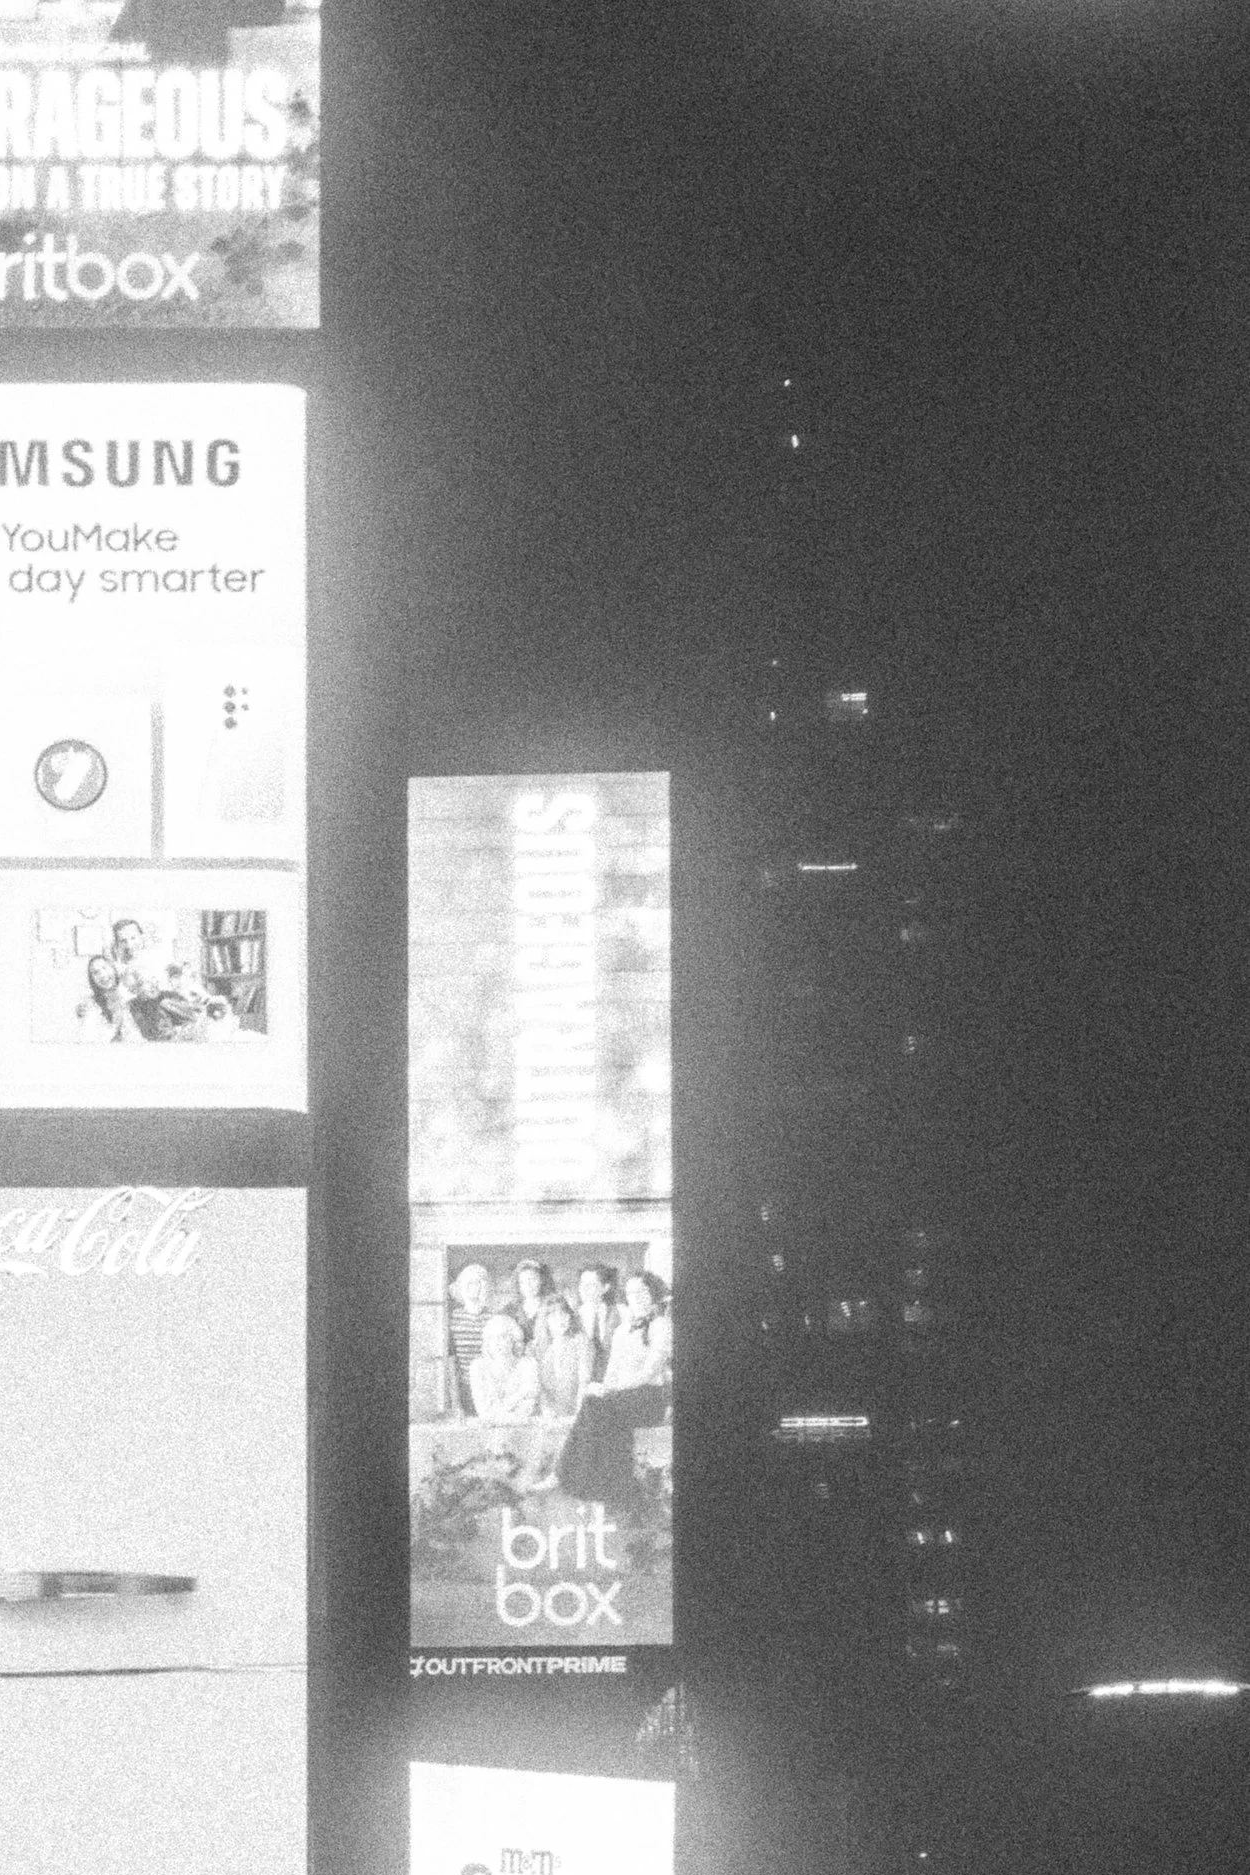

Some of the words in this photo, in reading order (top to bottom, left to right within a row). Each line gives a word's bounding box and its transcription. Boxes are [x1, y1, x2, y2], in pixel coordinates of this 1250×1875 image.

[79, 165, 166, 211] TRUE
[174, 165, 286, 211] STORY
[8, 563, 86, 604] day
[99, 564, 266, 594] smarter
[501, 1502, 617, 1570] brit
[496, 1565, 623, 1627] box
